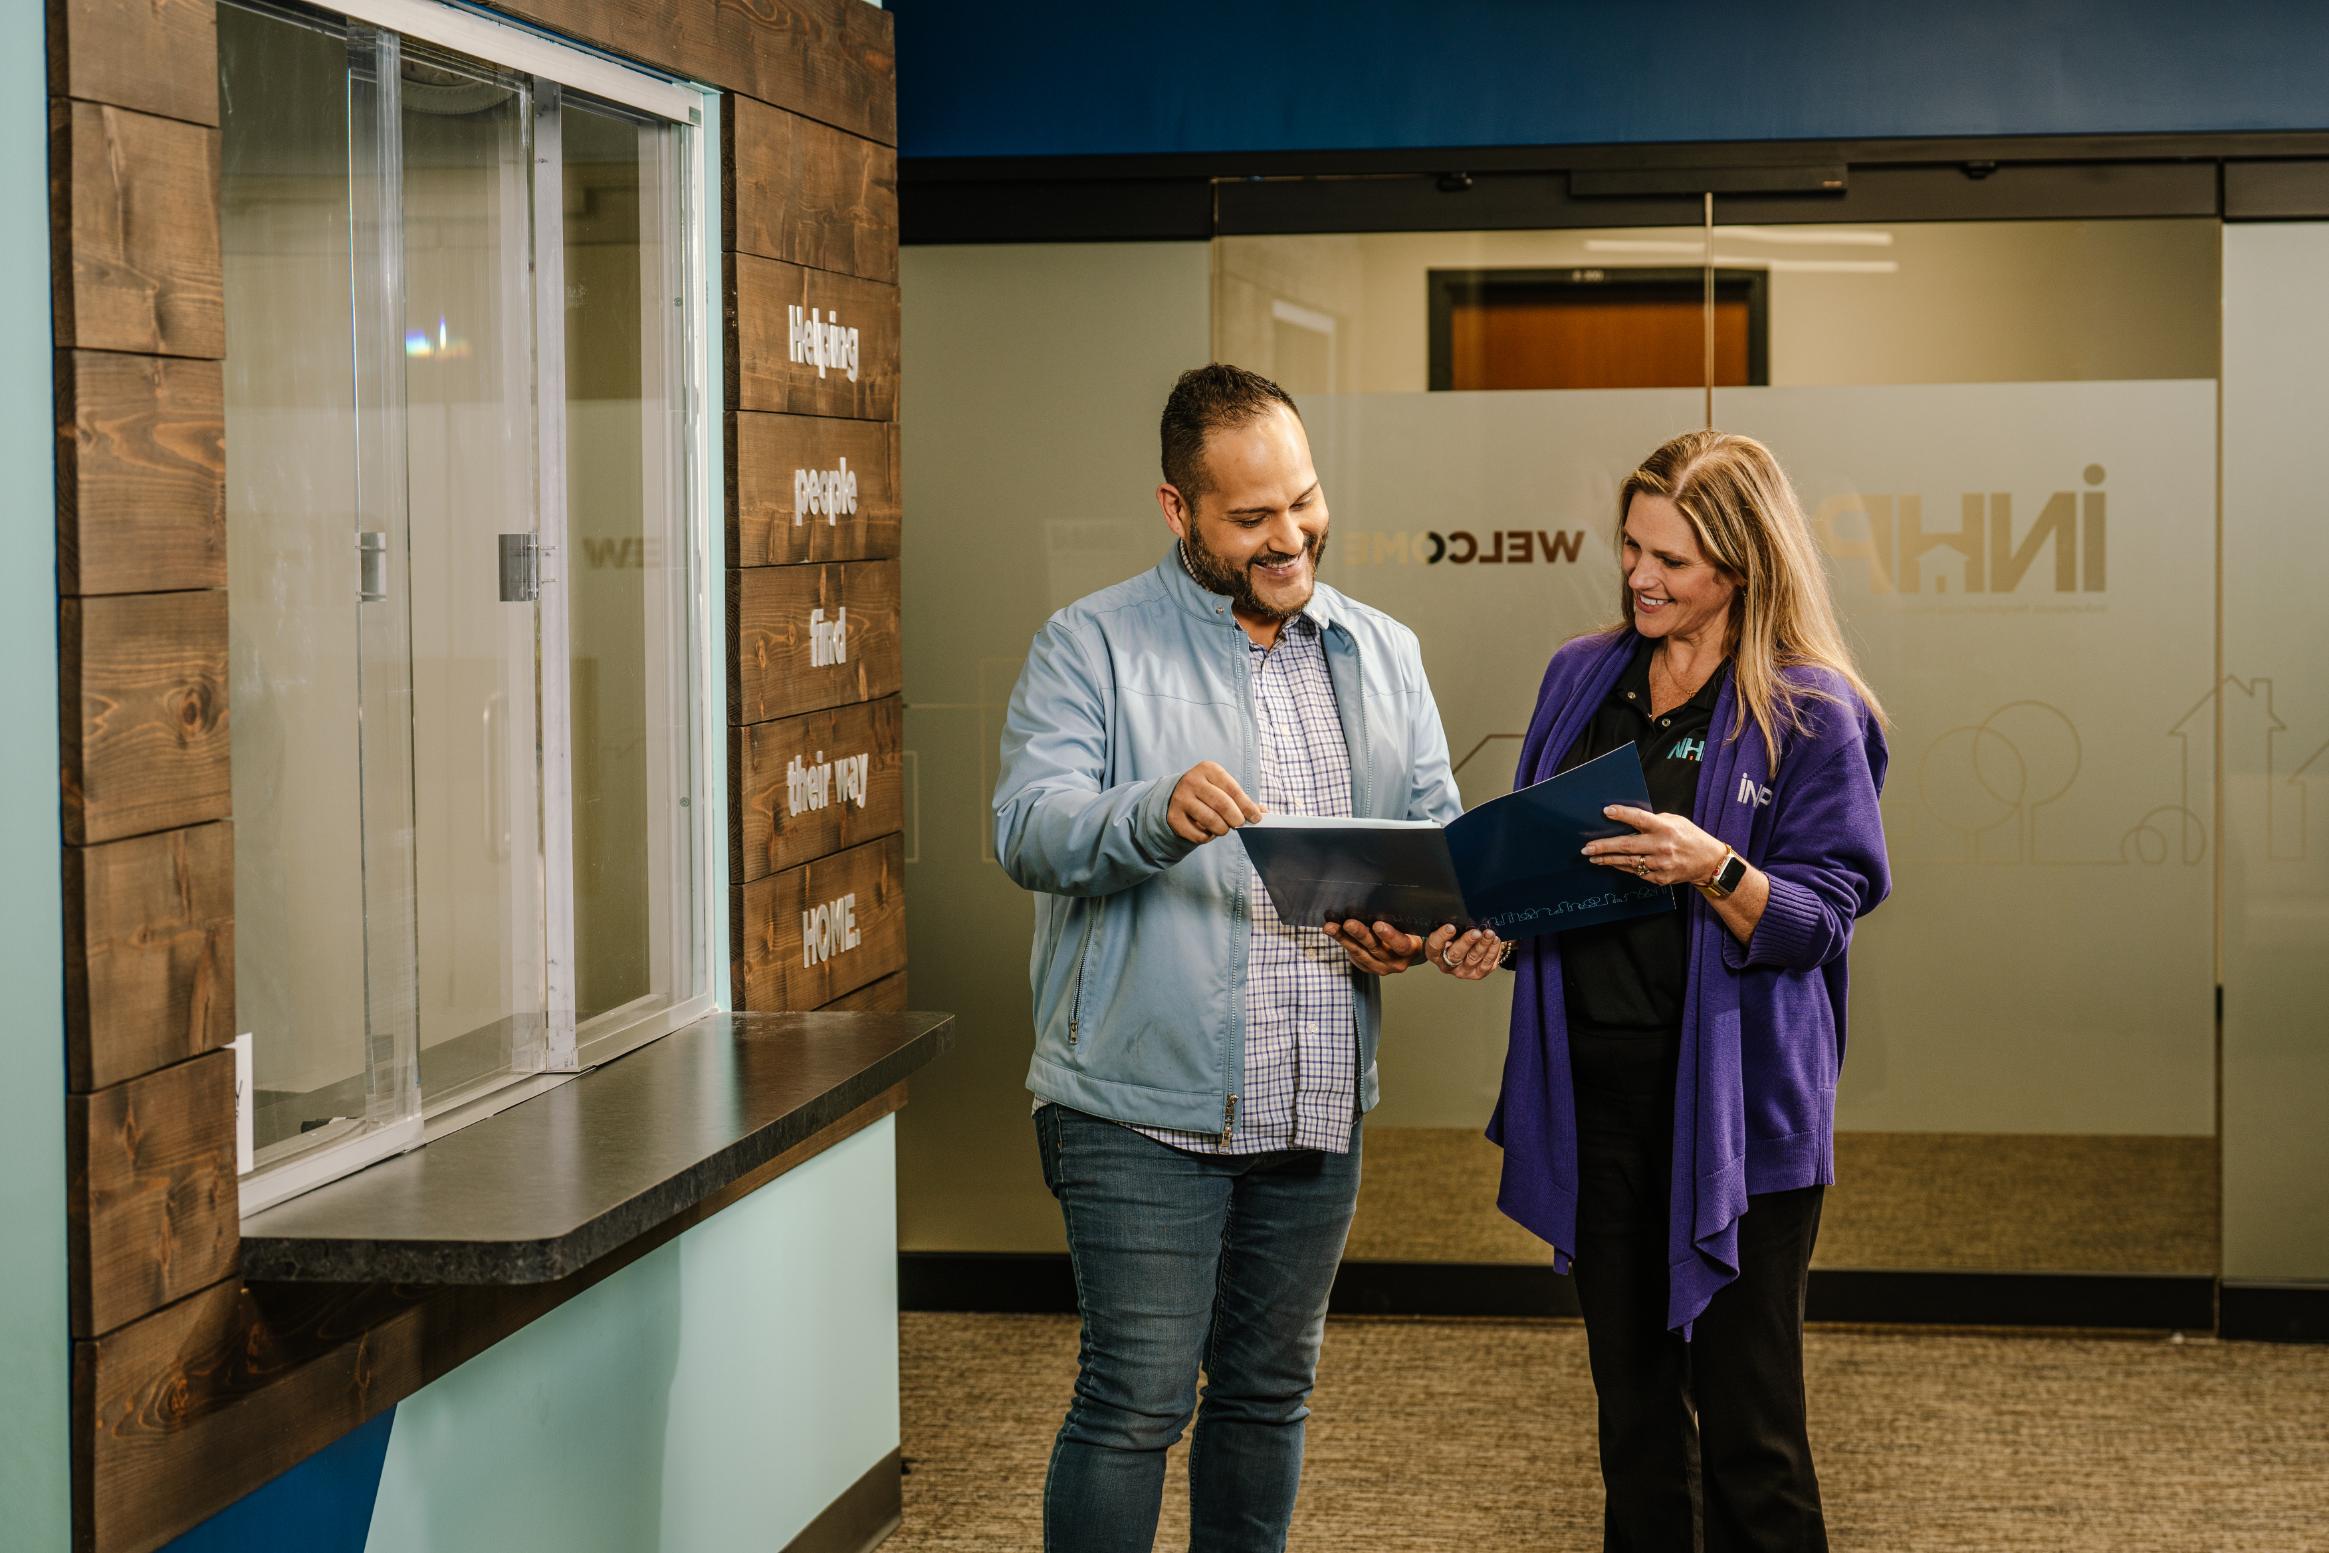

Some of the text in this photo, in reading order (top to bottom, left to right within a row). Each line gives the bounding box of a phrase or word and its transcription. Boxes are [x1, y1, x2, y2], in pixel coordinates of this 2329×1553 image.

[788, 304, 859, 383] Helping
[795, 456, 858, 527] people
[809, 606, 846, 668] find
[787, 750, 869, 817] their way
[802, 892, 861, 969] HOME.
